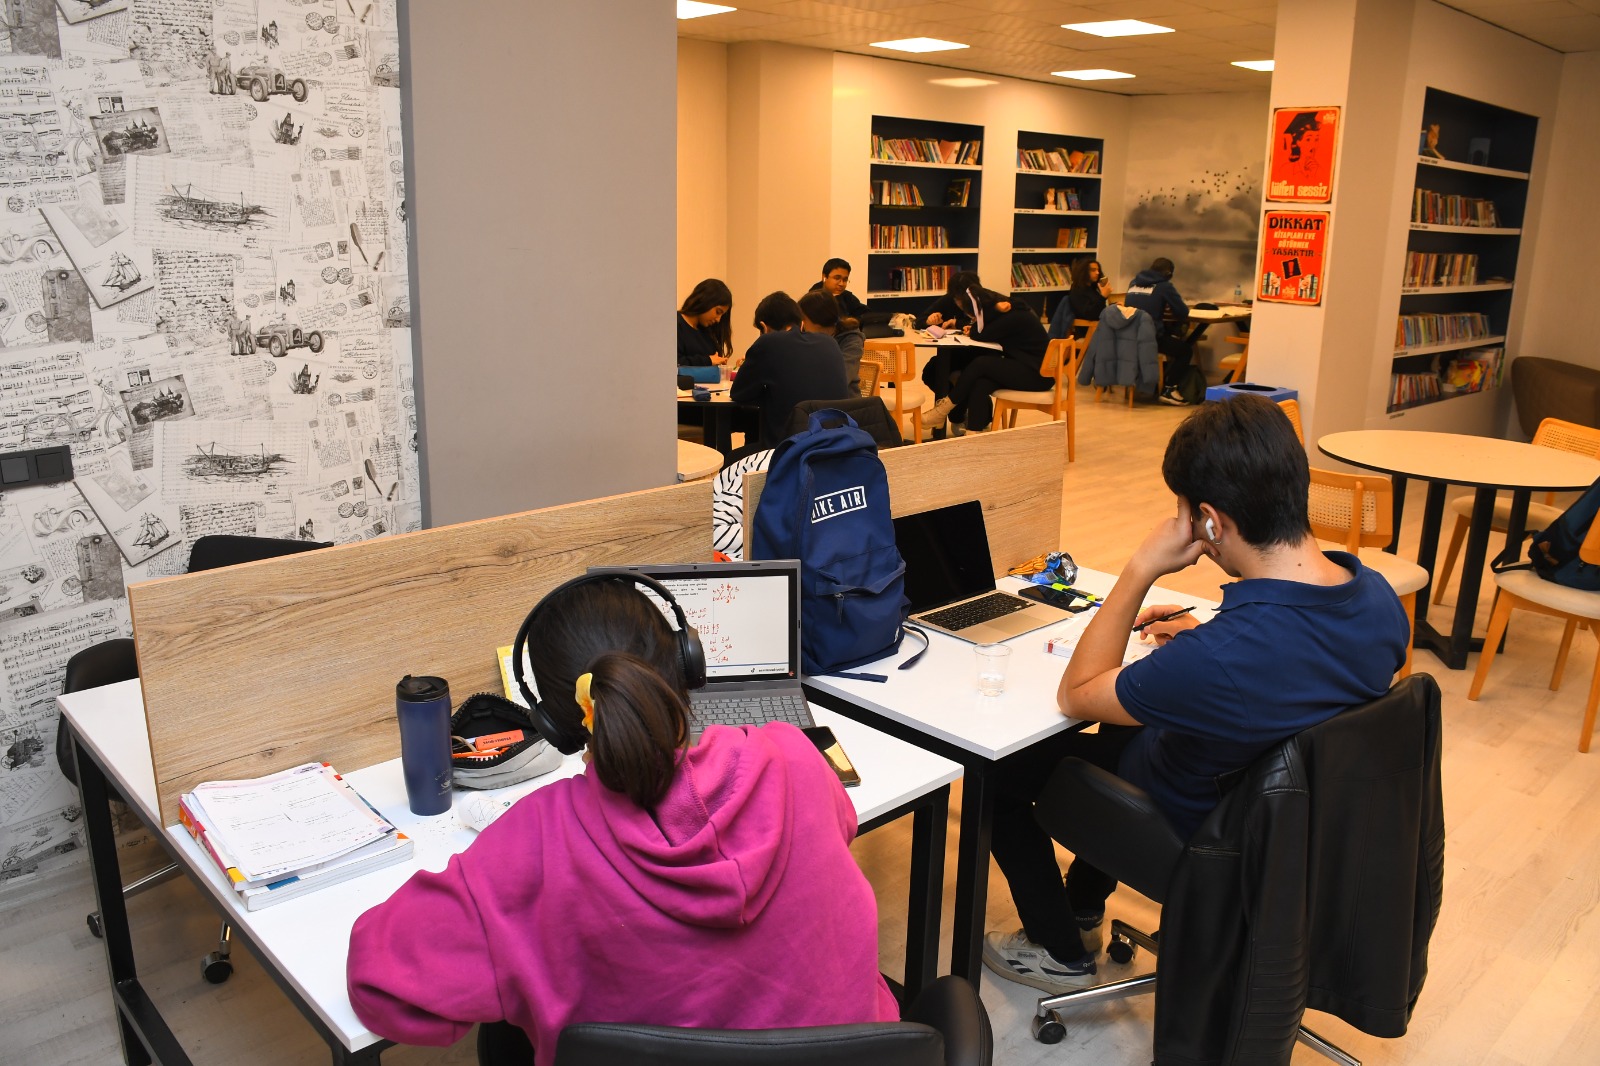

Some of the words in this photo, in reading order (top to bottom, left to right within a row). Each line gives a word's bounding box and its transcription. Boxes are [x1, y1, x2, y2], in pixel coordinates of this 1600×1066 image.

[276, 75, 285, 87] 4
[1270, 180, 1294, 196] lütfen
[1297, 182, 1328, 197] sessiz
[1269, 215, 1323, 230] DİKKAT
[1304, 232, 1316, 240] EVE
[1272, 248, 1314, 257] YASAKTIR
[293, 330, 302, 342] 4
[840, 491, 861, 510] AIR
